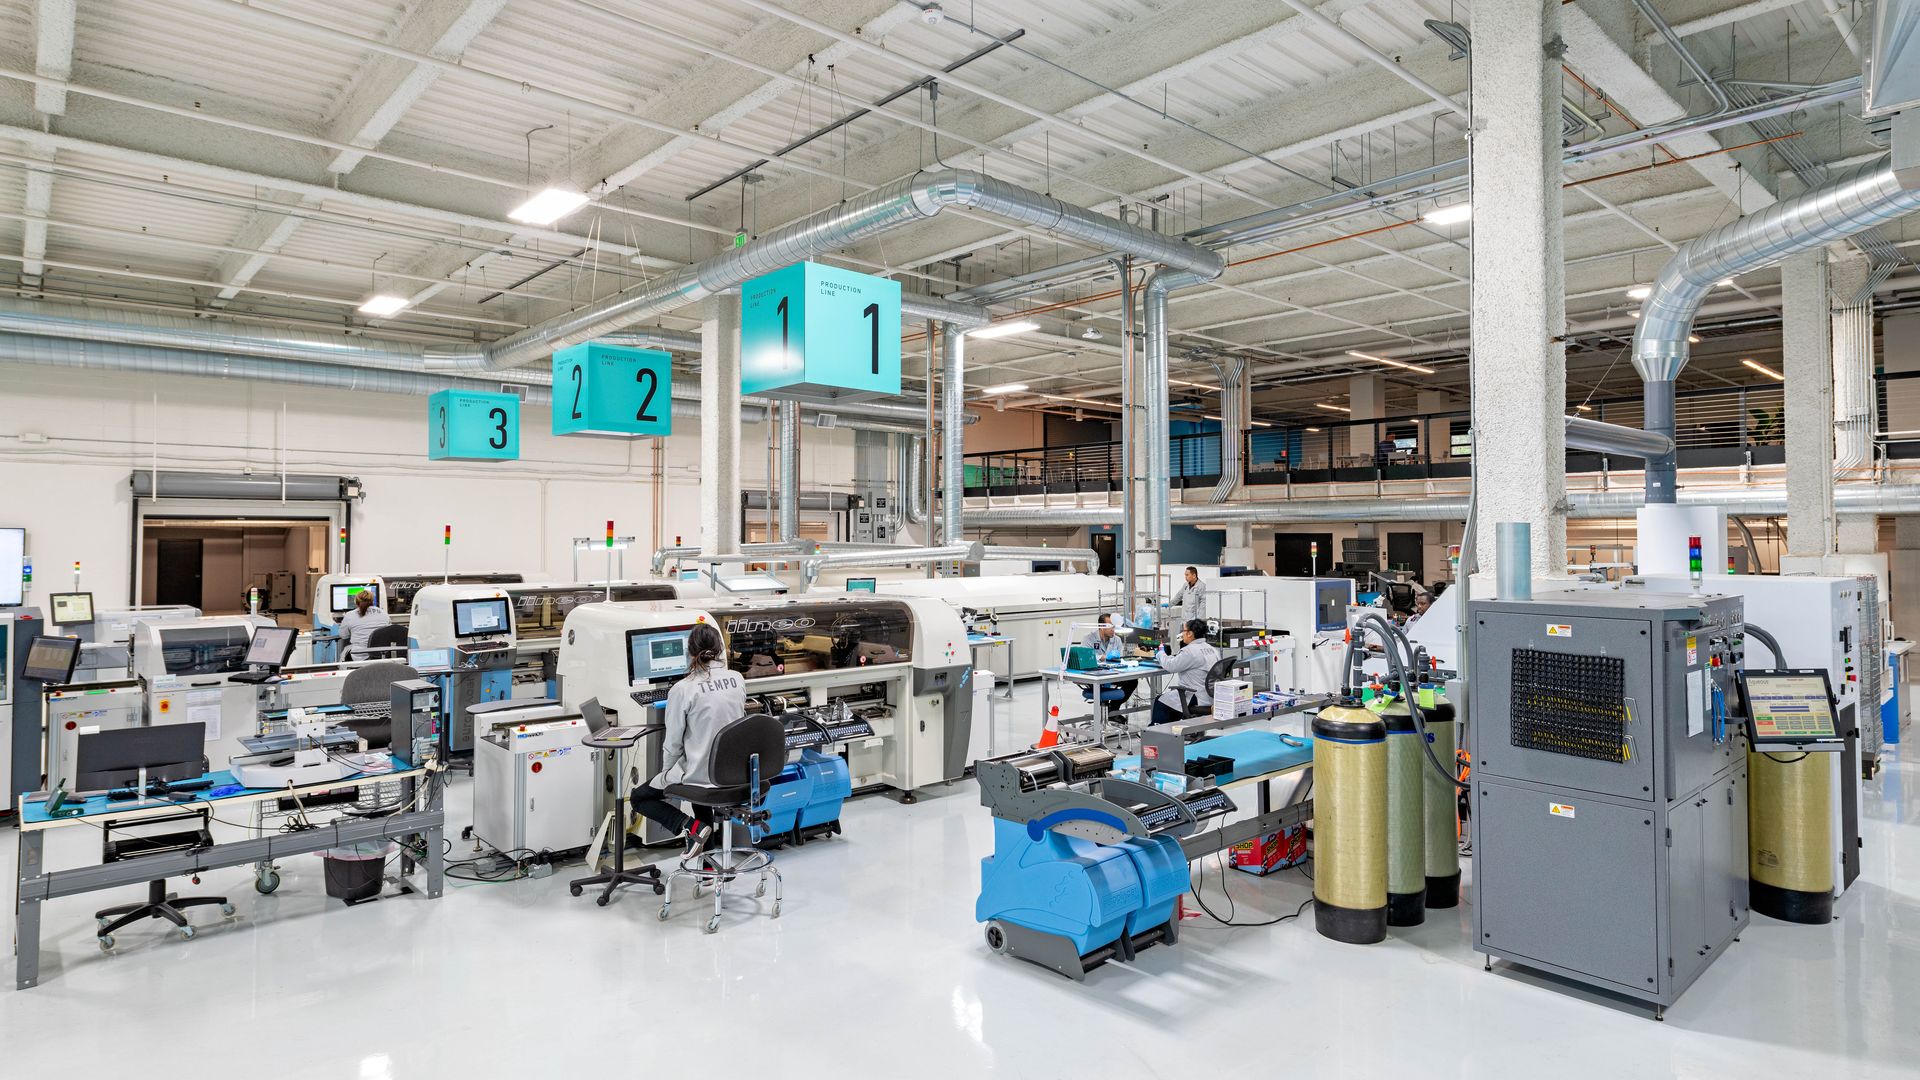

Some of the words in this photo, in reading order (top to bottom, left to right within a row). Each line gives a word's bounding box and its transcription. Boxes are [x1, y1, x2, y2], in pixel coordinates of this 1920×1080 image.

[750, 288, 777, 300] PRODUCTION
[820, 280, 862, 294] PRODUCTION
[820, 289, 836, 297] LINE
[750, 301, 760, 309] LINE
[777, 295, 788, 370] 1
[863, 302, 879, 375] 1
[601, 354, 637, 363] PRODUCTION
[572, 364, 582, 420] 2
[636, 367, 658, 422] 2
[439, 406, 446, 449] 3
[489, 407, 507, 450] 3
[697, 677, 738, 694] TEMPO
[1235, 841, 1254, 850] SHOP
